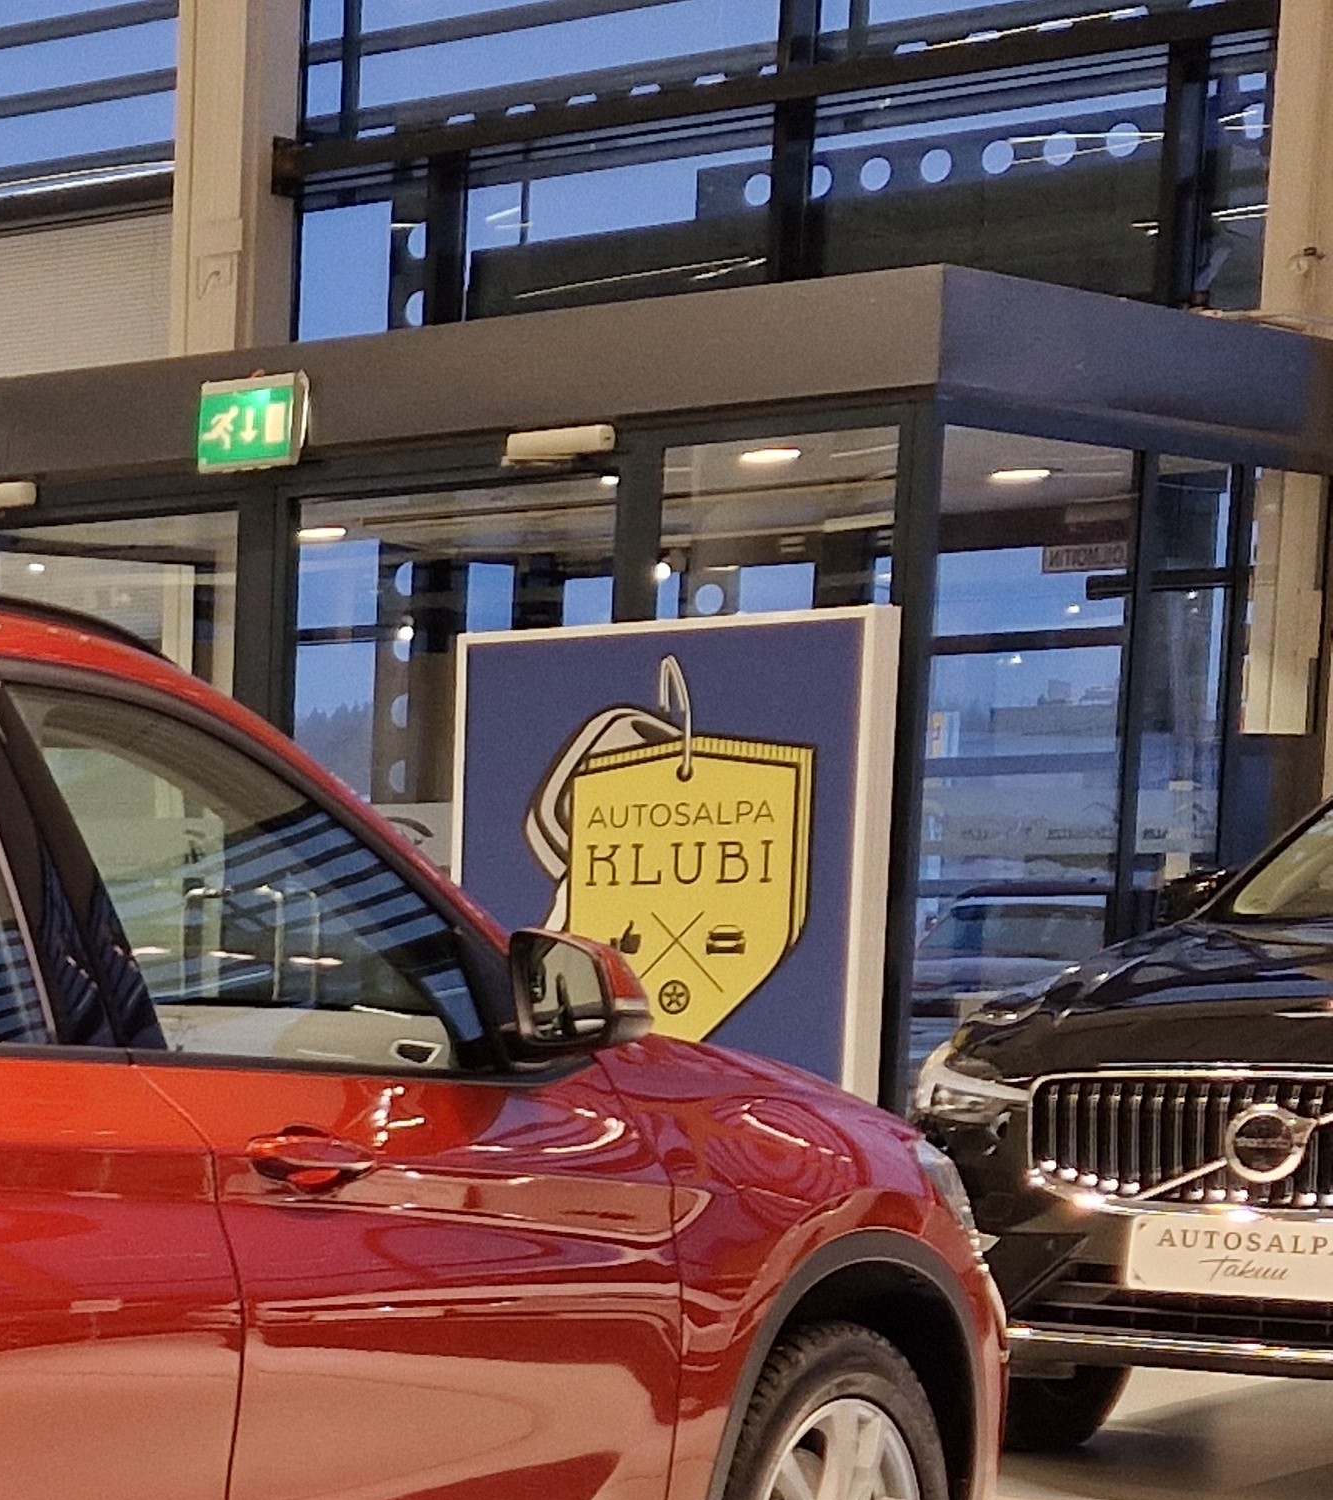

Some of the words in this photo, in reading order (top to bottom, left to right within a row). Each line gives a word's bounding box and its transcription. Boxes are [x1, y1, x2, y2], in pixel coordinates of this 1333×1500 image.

[587, 799, 775, 829] AUTOSALPA
[585, 839, 775, 887] KLUBI
[1198, 1256, 1290, 1282] Takuu
